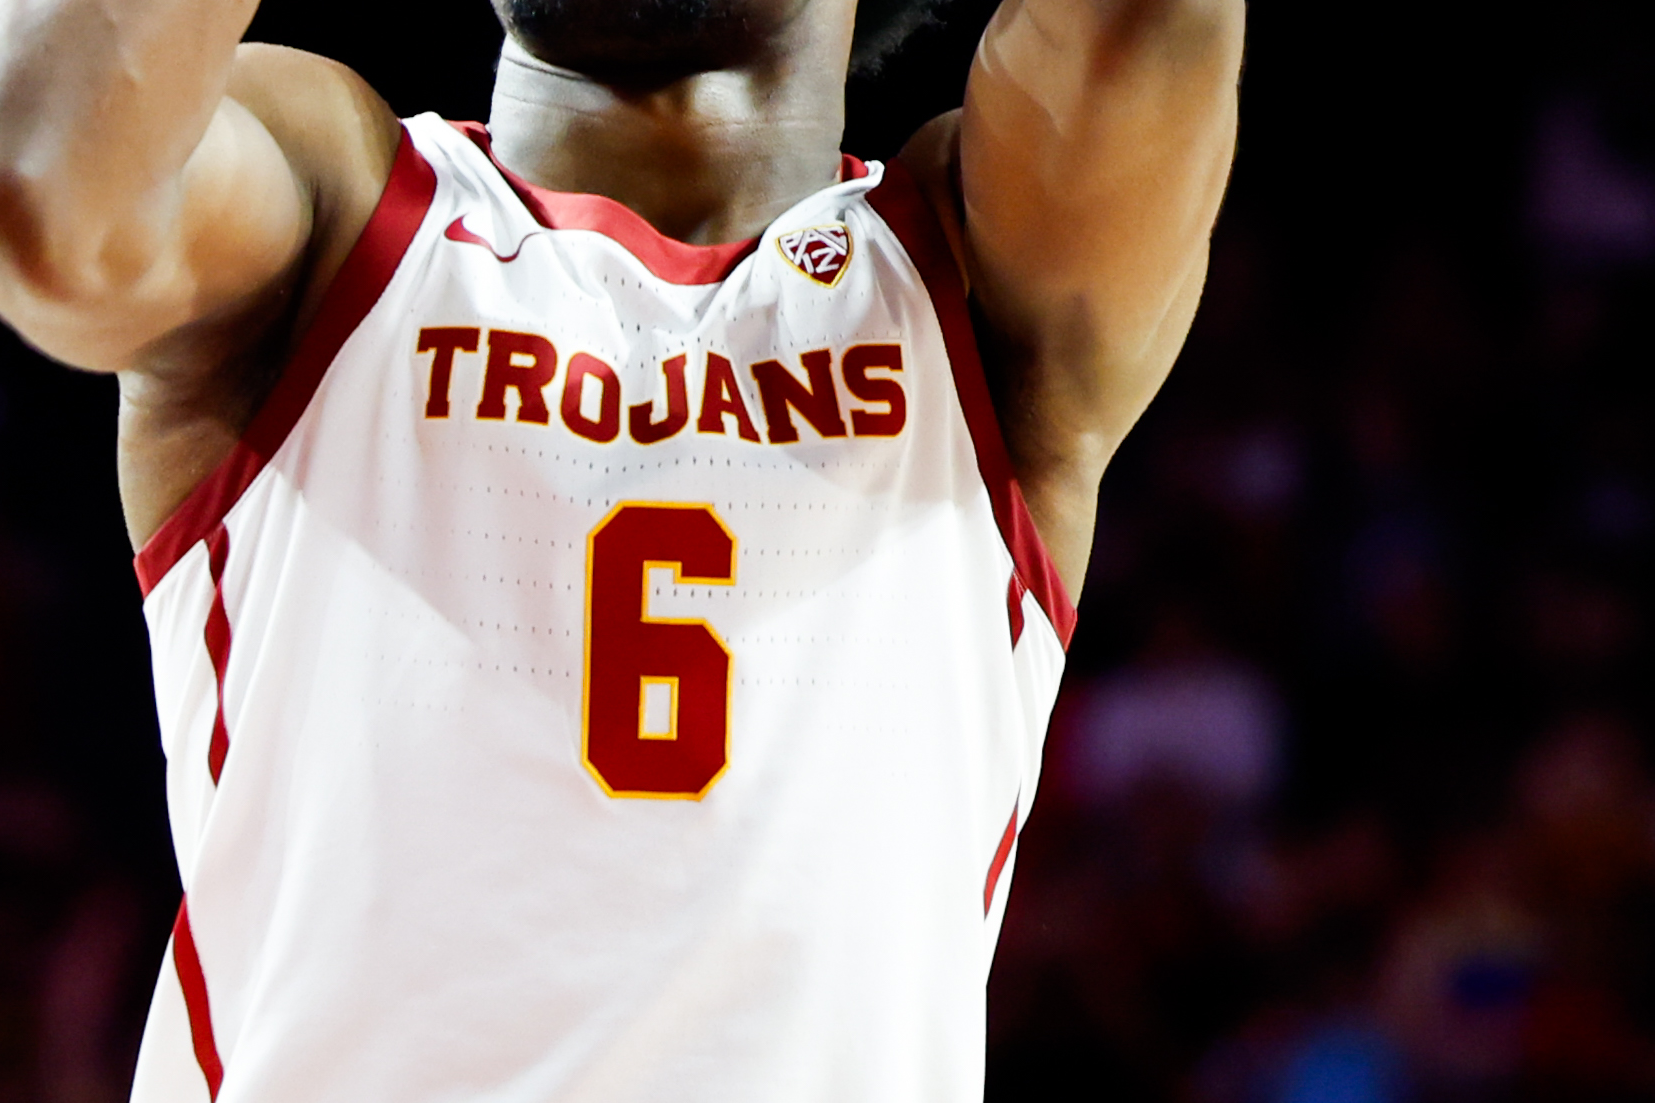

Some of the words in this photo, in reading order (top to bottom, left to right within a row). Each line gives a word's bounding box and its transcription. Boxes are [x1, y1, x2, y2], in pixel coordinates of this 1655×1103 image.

[779, 226, 847, 265] PAC
[802, 247, 840, 274] 12
[416, 326, 907, 444] TROJANS
[581, 500, 737, 802] 6
